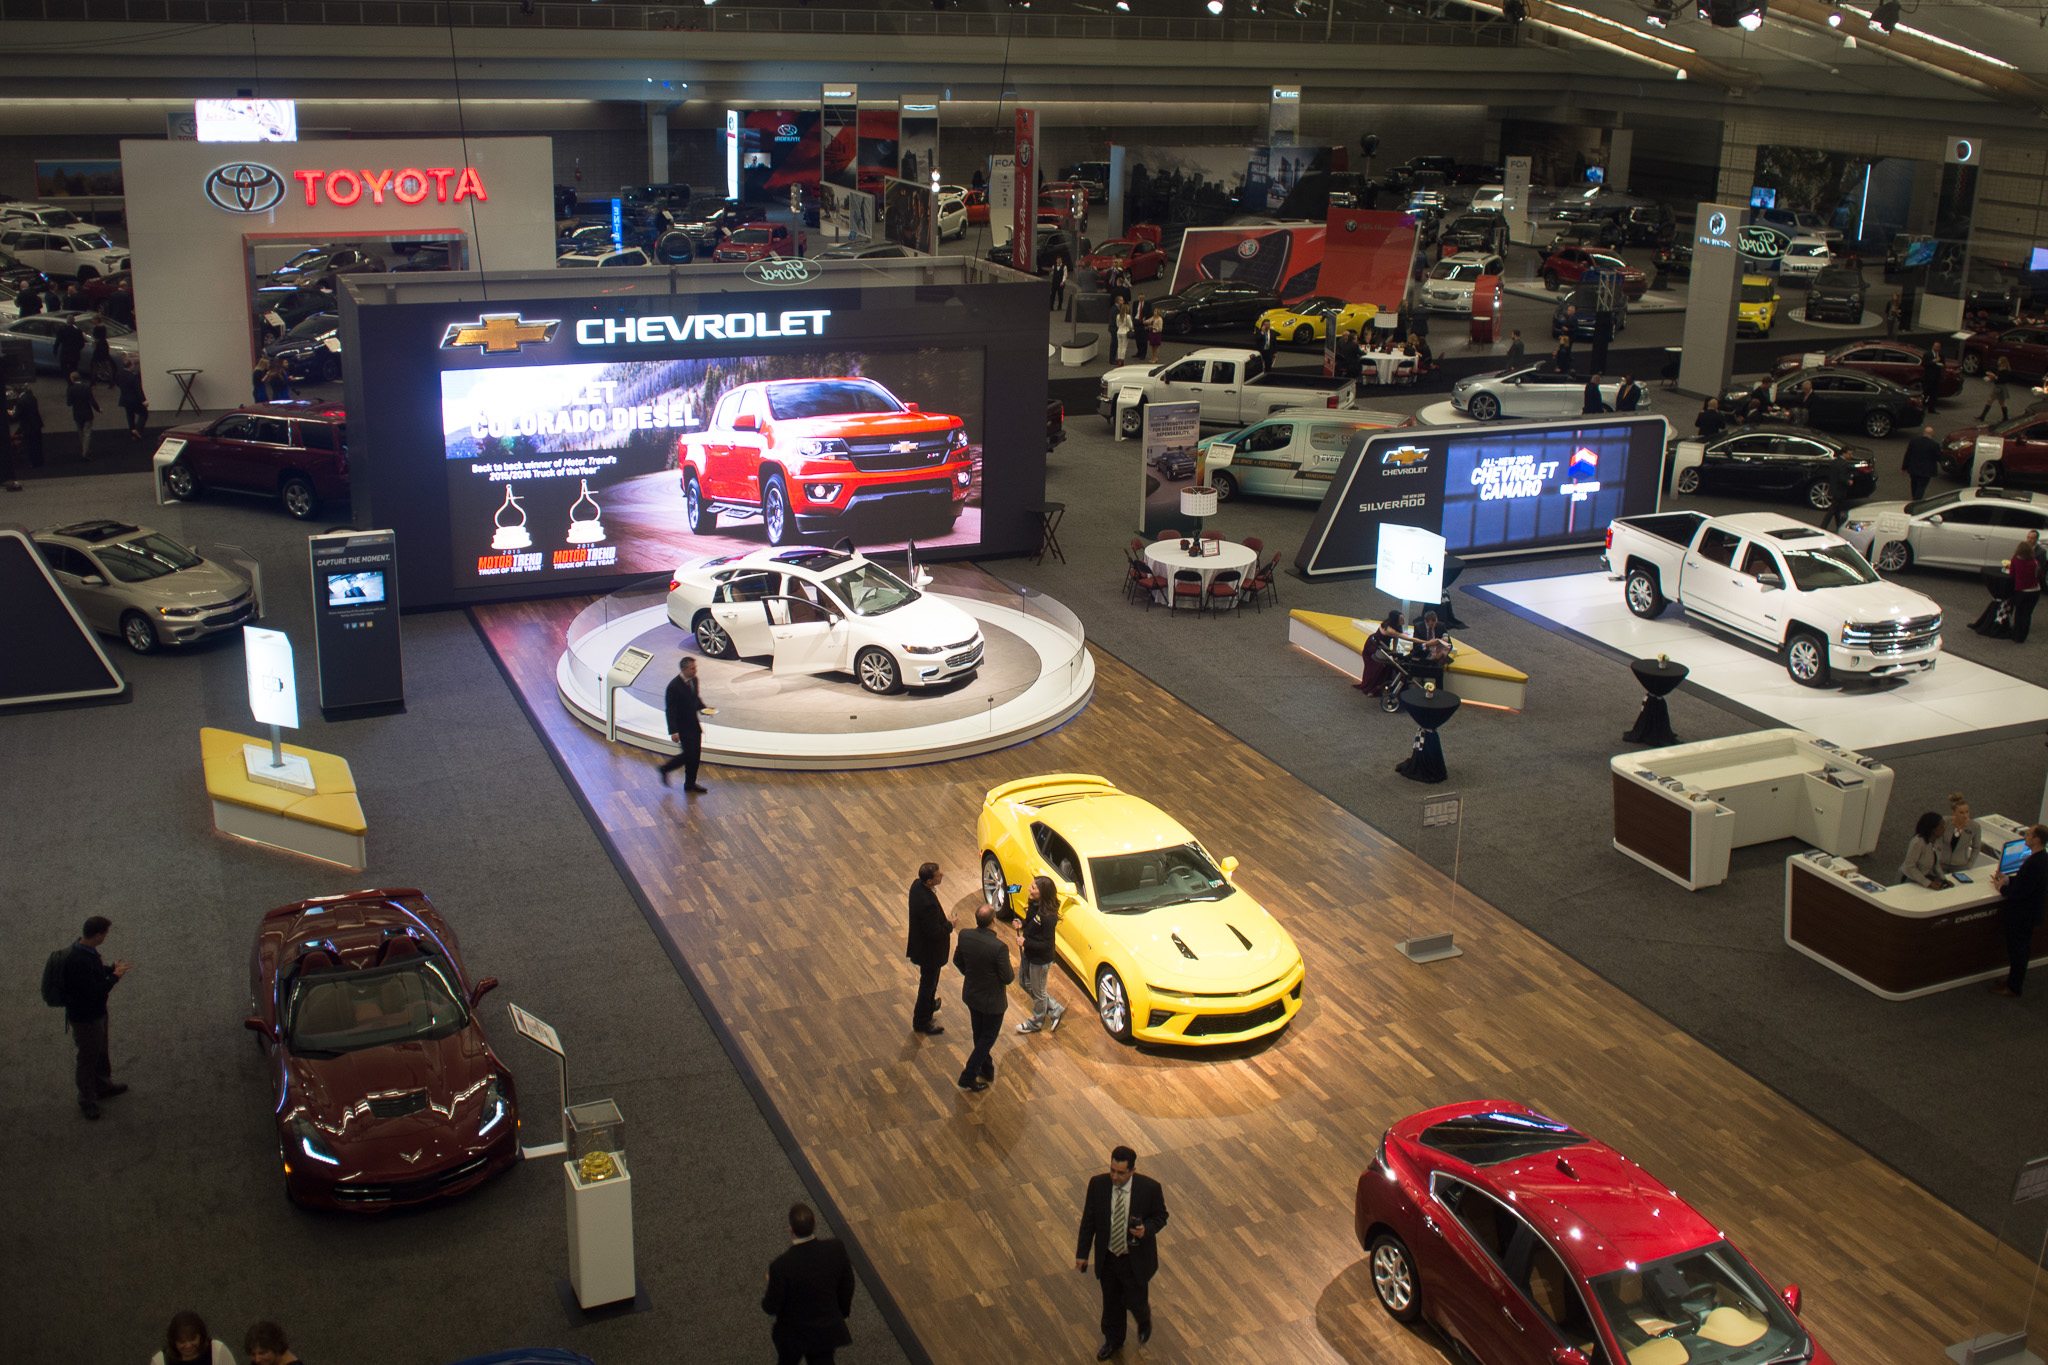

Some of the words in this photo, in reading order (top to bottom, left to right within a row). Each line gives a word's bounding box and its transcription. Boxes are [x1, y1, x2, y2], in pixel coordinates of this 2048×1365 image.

[294, 167, 488, 207] TOYOTA
[575, 309, 832, 346] CHEVROLET
[470, 408, 607, 439] COLORADO
[612, 403, 700, 430] DIESEL
[471, 463, 492, 473] Back
[493, 463, 503, 472] to
[503, 462, 524, 471] back
[524, 460, 552, 470] winner
[553, 459, 562, 468] of
[563, 457, 587, 468] Motor
[588, 455, 617, 466] Trend's
[1481, 457, 1516, 468] ALL-NEW
[532, 468, 555, 478] Truck
[556, 467, 565, 477] of
[566, 466, 579, 476] the
[1382, 466, 1428, 476] CHEVROLET
[1470, 461, 1559, 485] CHEVROLET
[1480, 480, 1542, 501] CAMARO
[1359, 498, 1426, 513] SILVERADO
[317, 557, 347, 567] CAPTURE
[361, 554, 391, 563] MOMENT.
[553, 562, 575, 570] TRUCK
[478, 567, 500, 576] TRUCK
[1954, 909, 1998, 923] CHEVROLET
